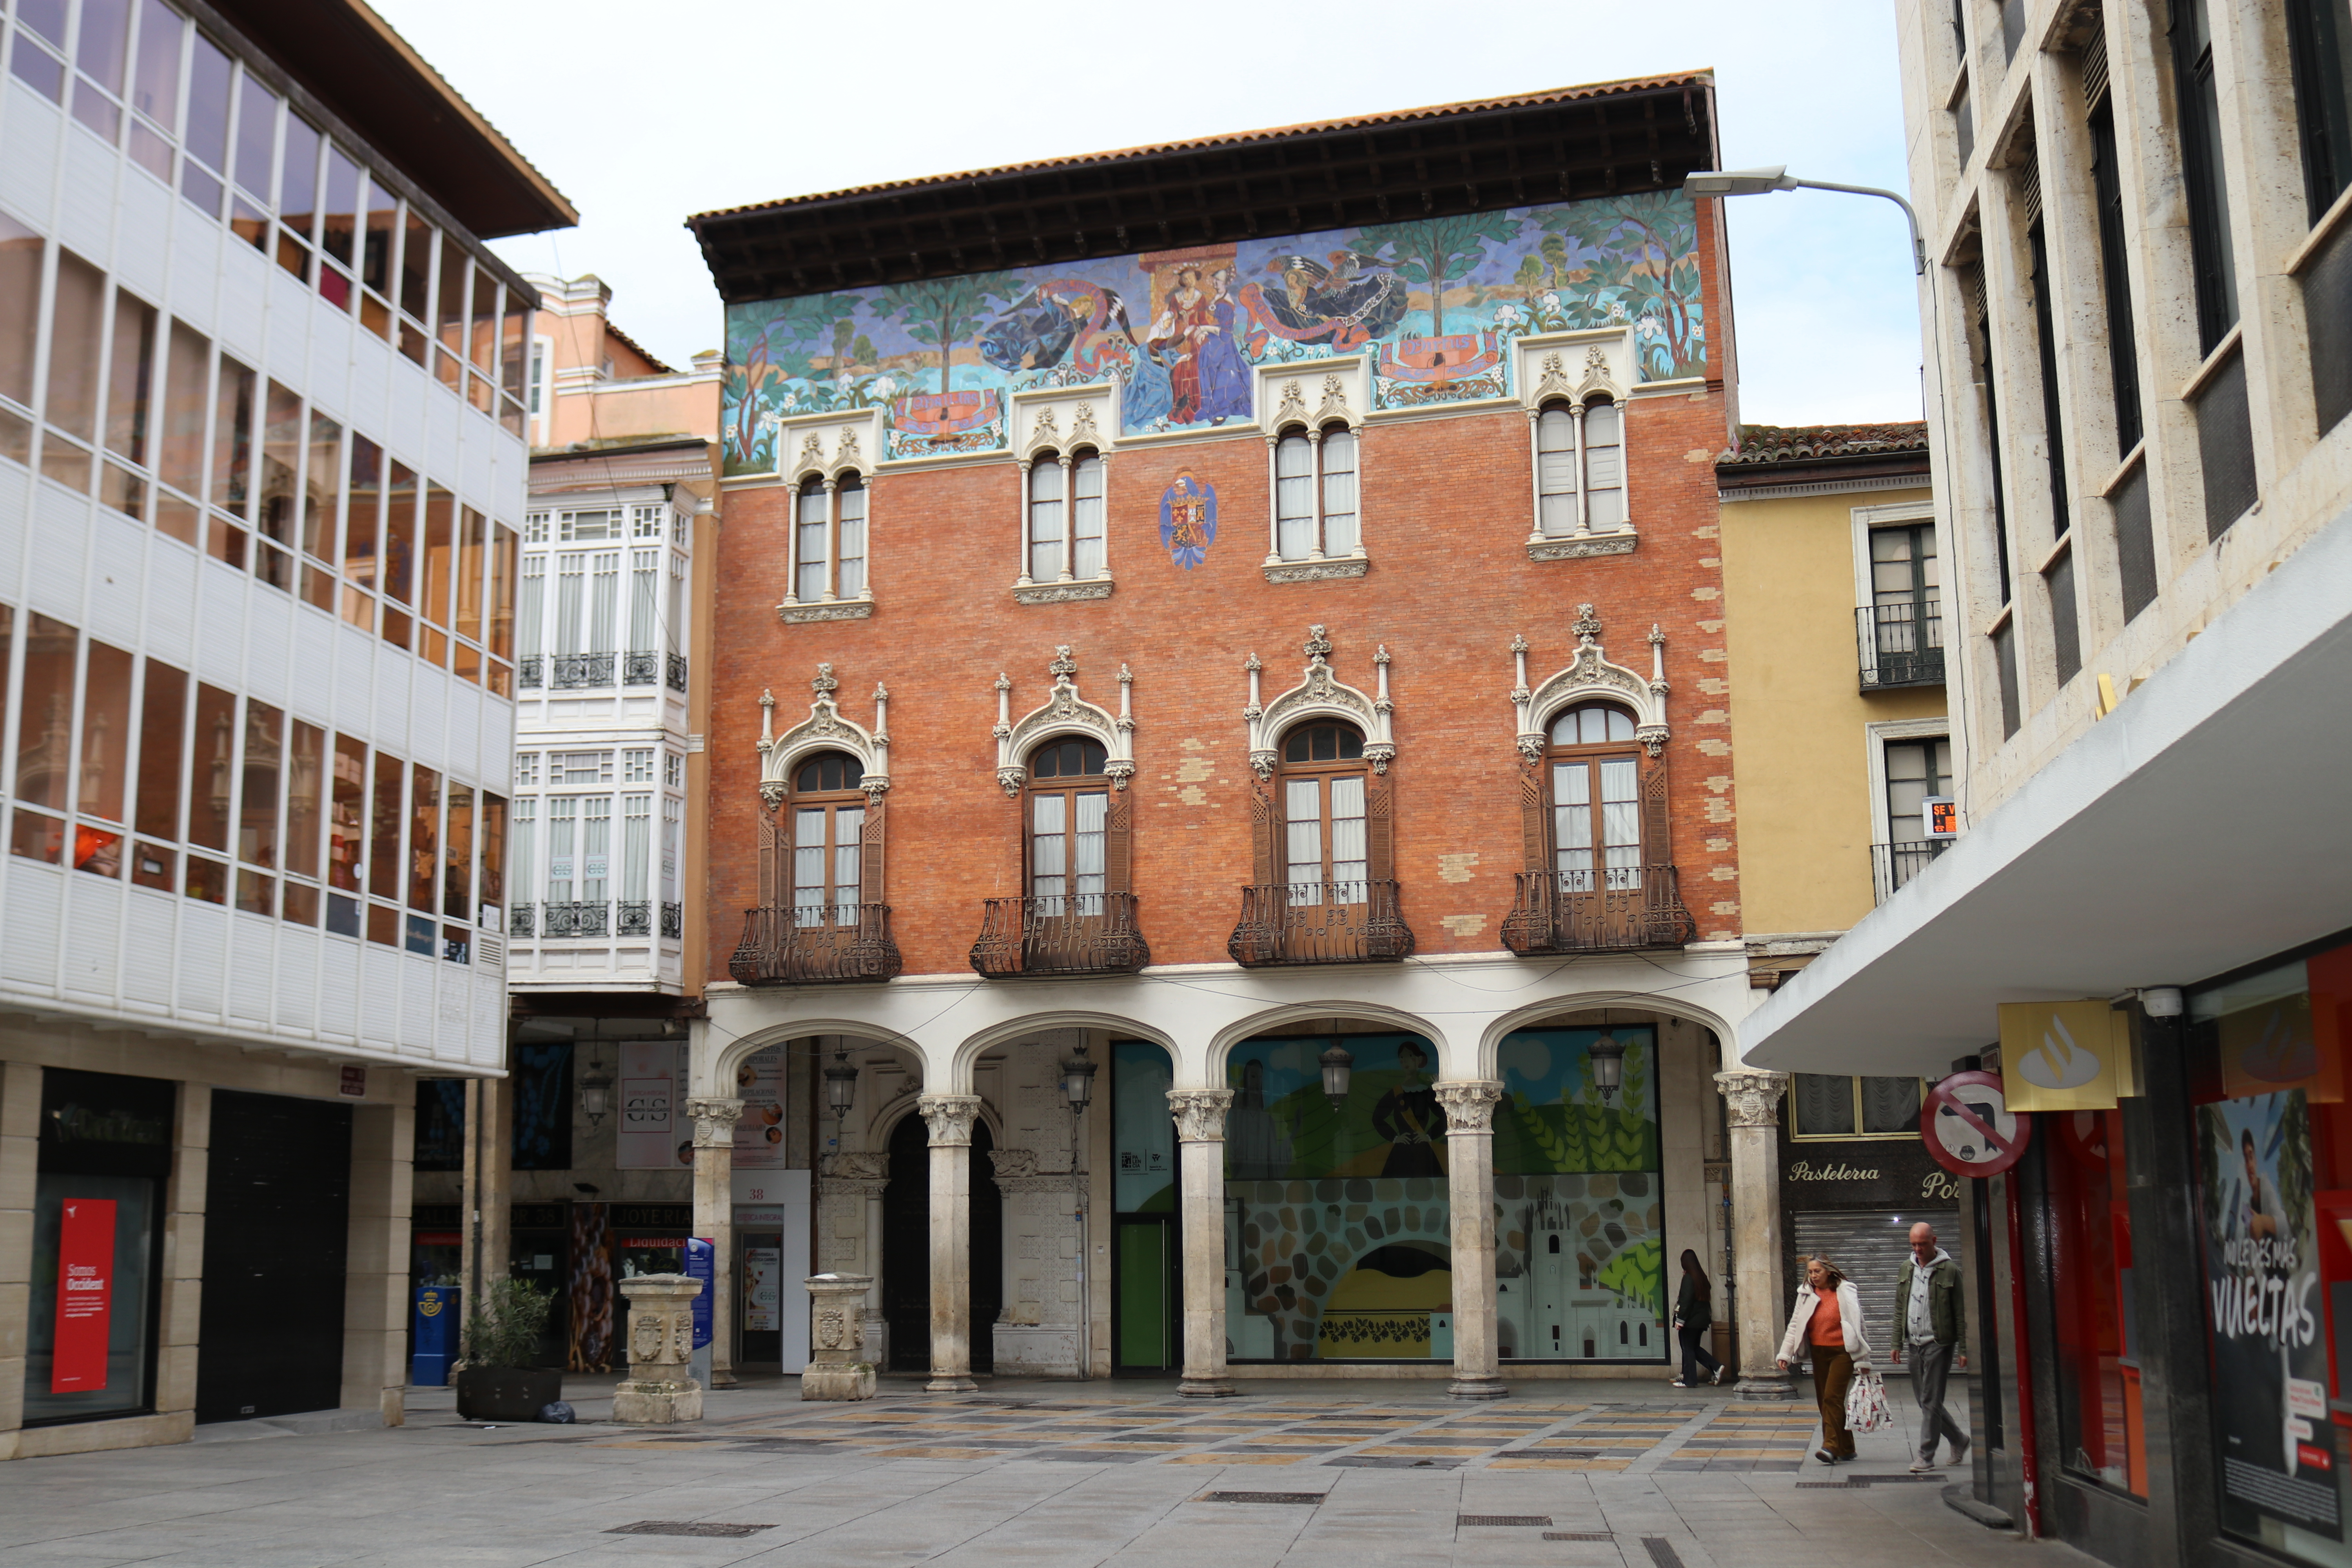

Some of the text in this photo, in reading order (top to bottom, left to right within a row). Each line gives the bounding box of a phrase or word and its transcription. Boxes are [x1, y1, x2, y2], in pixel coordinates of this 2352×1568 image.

[1934, 805, 1946, 815] SE
[749, 1188, 764, 1200] 38
[536, 1209, 556, 1223] 38
[618, 1209, 692, 1224] JOYERIA
[630, 1238, 686, 1247] Liquidaci
[68, 1263, 96, 1277] Somos
[66, 1277, 104, 1291] Occident
[2212, 1271, 2317, 1349] VUELTAS
